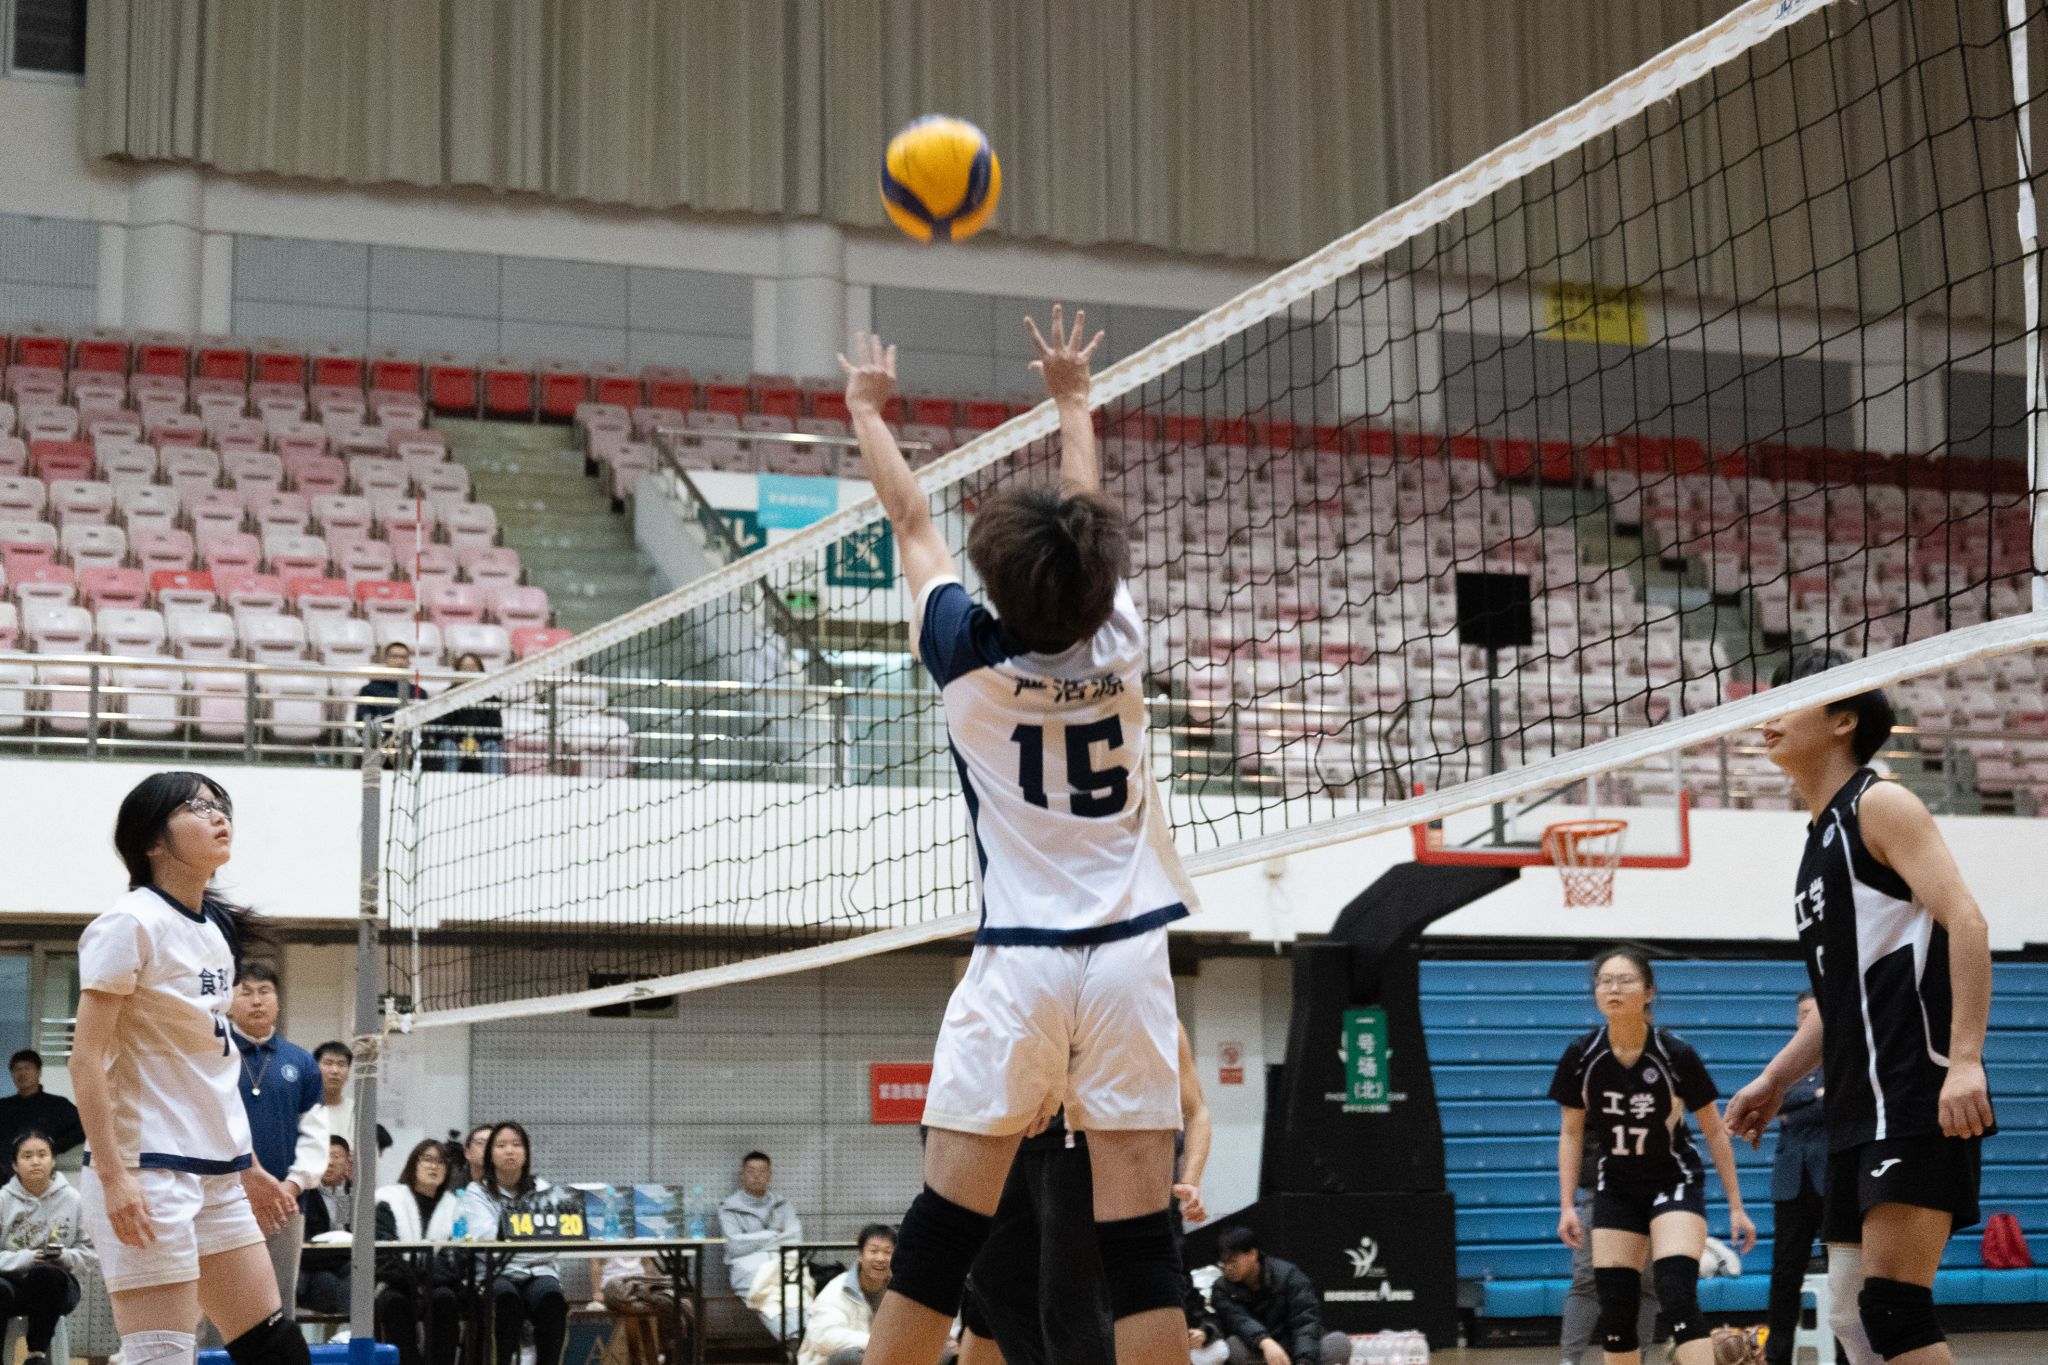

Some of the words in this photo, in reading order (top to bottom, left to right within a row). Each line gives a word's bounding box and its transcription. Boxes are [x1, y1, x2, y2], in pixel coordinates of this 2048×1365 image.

[1010, 713, 1129, 818] 15
[1794, 876, 1826, 933] 工学
[1602, 1091, 1656, 1119] 工学
[1611, 1125, 1649, 1156] 17
[509, 1213, 534, 1236] 14
[559, 1213, 584, 1236] 20
